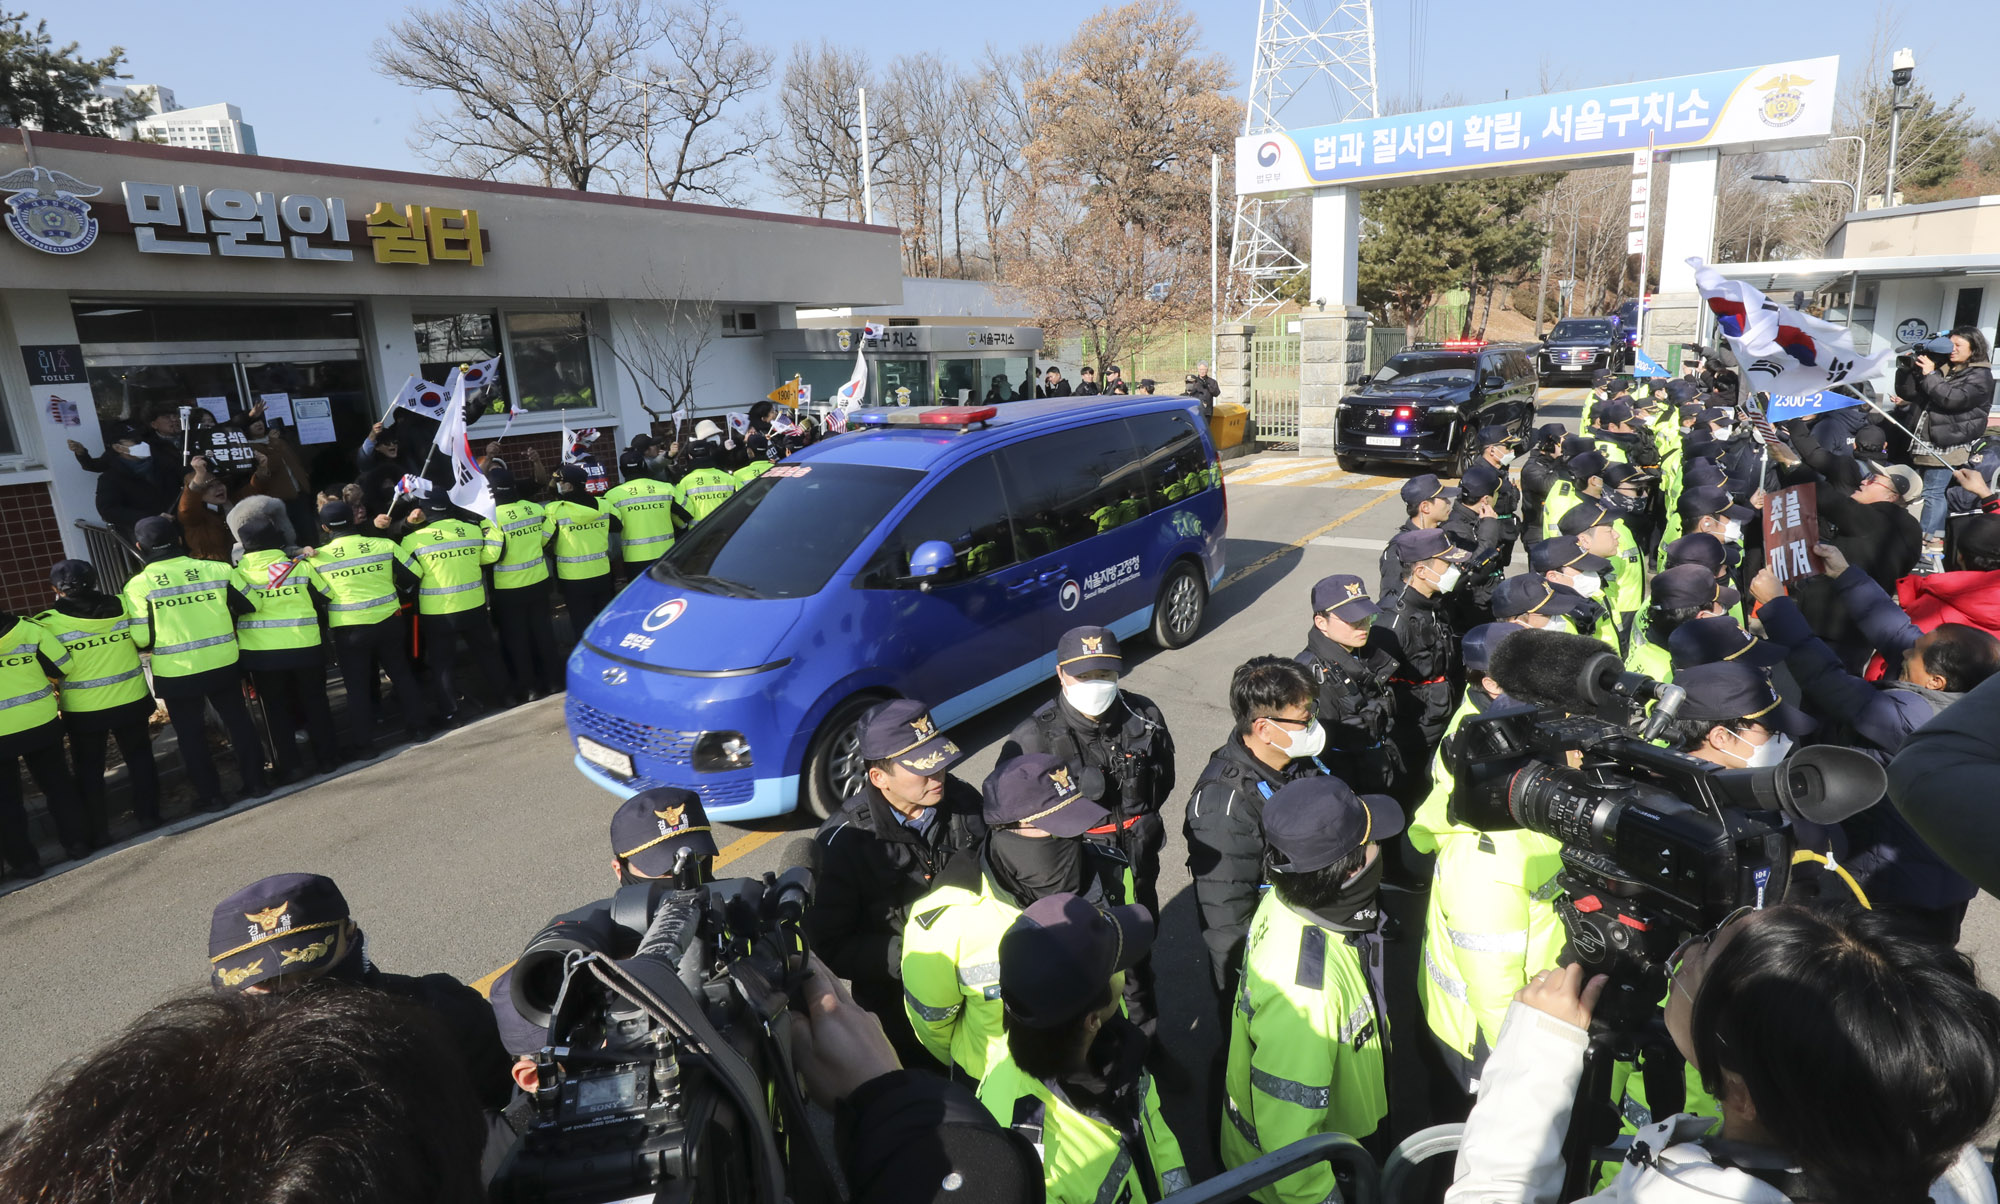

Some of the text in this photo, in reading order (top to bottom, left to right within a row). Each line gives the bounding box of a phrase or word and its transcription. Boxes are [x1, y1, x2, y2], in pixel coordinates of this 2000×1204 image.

[1313, 131, 1365, 171] 법과
[1372, 119, 1453, 165] 질서의
[1463, 111, 1530, 152] 확립,
[1541, 88, 1710, 145] 서울구치소
[1256, 172, 1281, 184] 법무부
[121, 180, 485, 267] 민원인 쉼터
[978, 332, 1015, 346] 서울구치소
[1900, 329, 1924, 337] 143
[41, 374, 76, 382] TOILET
[1774, 393, 1824, 408] 2300-2
[213, 446, 255, 462] 잘한다
[694, 492, 729, 501] POLICE
[627, 502, 666, 513] POLICE
[1770, 490, 1801, 535] 촛불
[509, 523, 543, 539] POLICE
[568, 521, 607, 532] POLICE
[430, 547, 477, 561] POLICE
[330, 563, 384, 580] POLICE
[1083, 555, 1140, 590] 서울지방교정청
[154, 592, 218, 610] POLICE
[63, 631, 132, 653] POLICE
[619, 632, 656, 652] 법무부
[0, 655, 34, 668] ICE
[1628, 806, 1661, 820] Panasonic
[589, 1101, 620, 1113] SONY
